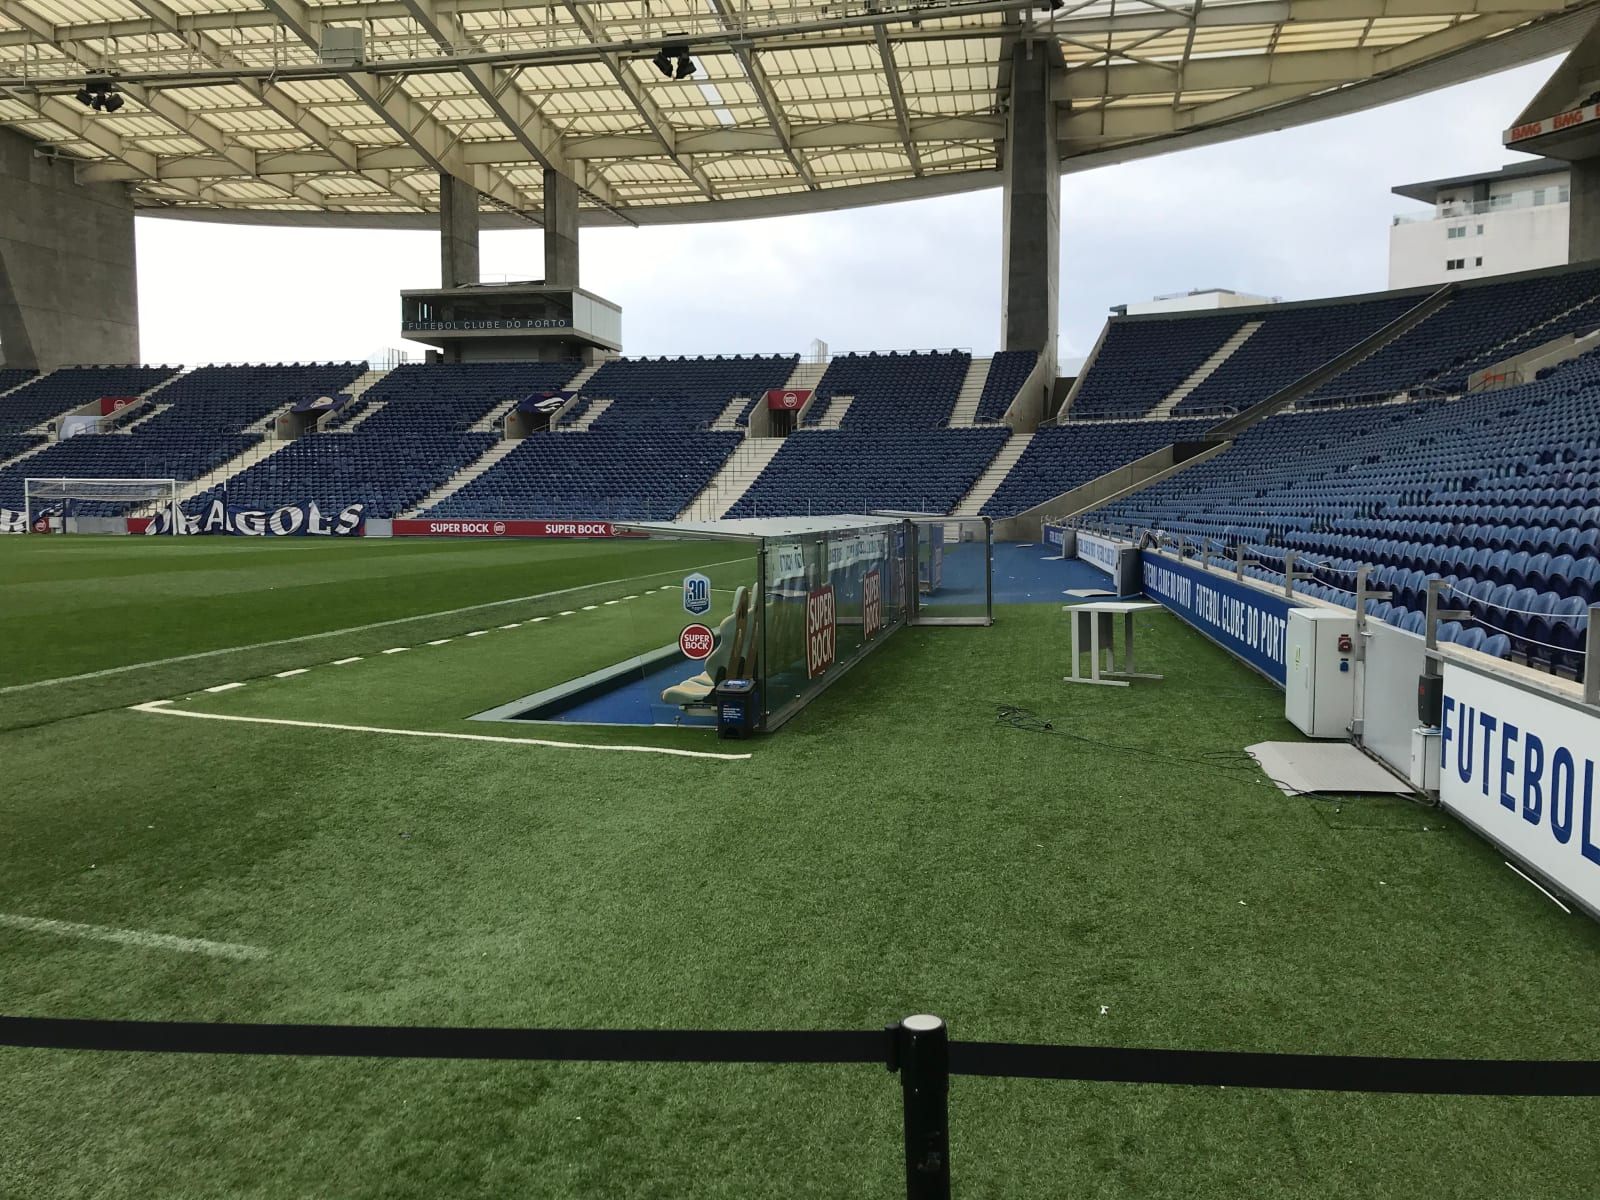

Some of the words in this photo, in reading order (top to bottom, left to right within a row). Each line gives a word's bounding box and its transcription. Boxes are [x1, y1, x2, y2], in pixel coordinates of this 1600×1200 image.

[1511, 121, 1542, 141] BMG
[1552, 109, 1584, 130] BMG
[408, 321, 458, 331] FUTEBOL
[464, 320, 500, 330] CLUBE
[506, 320, 521, 329] DO
[527, 318, 566, 328] PORTO
[430, 522, 459, 533] SUPER
[461, 523, 489, 533] BOCK
[545, 523, 575, 534] SUPER
[577, 523, 606, 534] BOCK
[688, 579, 706, 600] 30
[865, 572, 880, 606] SUPER
[809, 592, 833, 634] SUPER
[866, 601, 880, 634] BOCK
[1195, 583, 1221, 628] FUTEBOL
[1222, 594, 1245, 642] CLUBE
[1246, 604, 1259, 649] DO
[1260, 610, 1288, 666] PORT
[683, 633, 710, 642] SUPER
[685, 641, 708, 650] BOCK
[811, 626, 832, 671] BOCK
[1441, 694, 1600, 867] FUTEBOL
